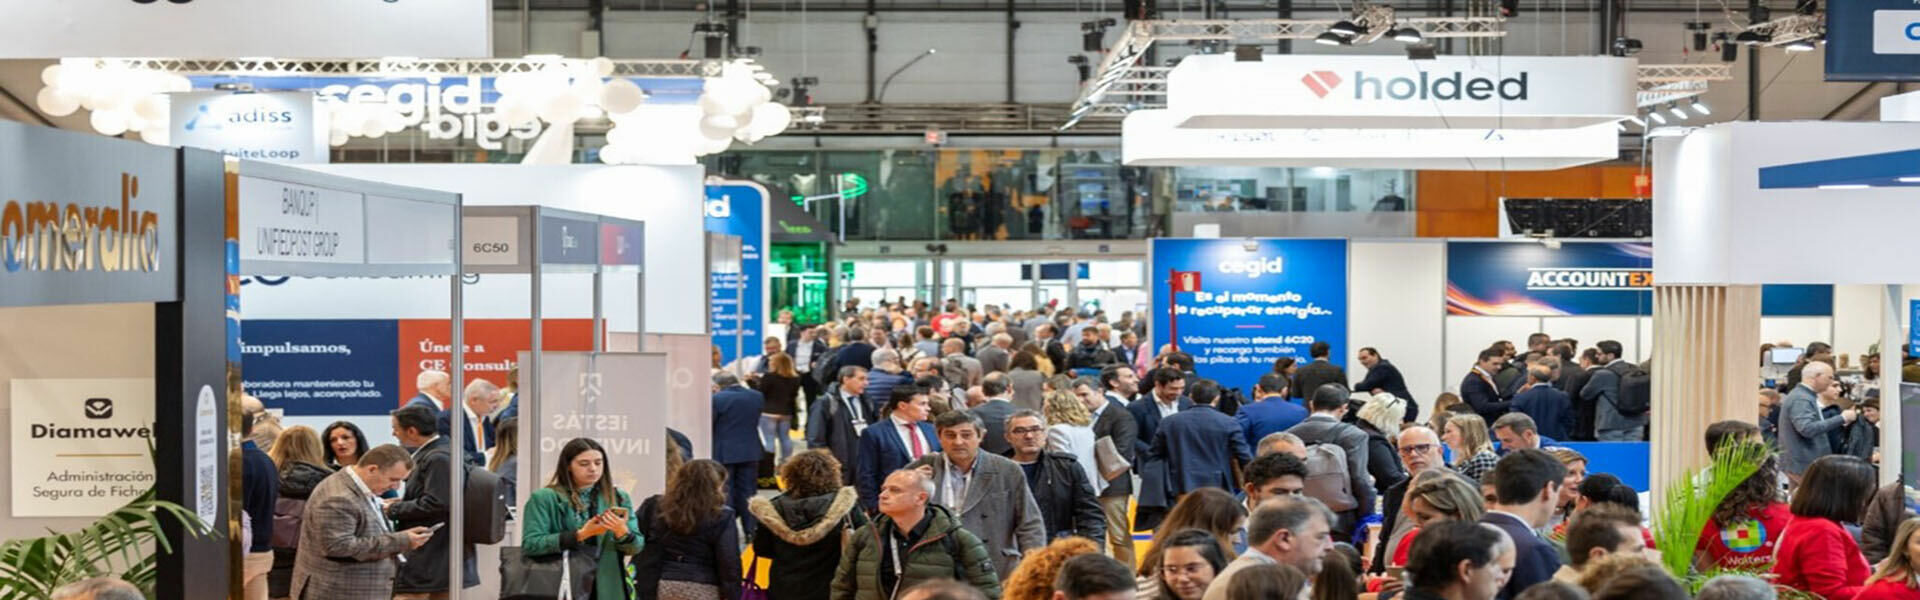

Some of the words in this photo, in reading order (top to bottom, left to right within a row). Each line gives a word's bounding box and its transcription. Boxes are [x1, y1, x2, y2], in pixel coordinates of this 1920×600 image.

[1354, 70, 1528, 101] holded
[228, 107, 292, 123] adiss
[313, 230, 338, 257] GROUP
[473, 243, 509, 253] 6C50
[1218, 256, 1283, 278] cegid
[1195, 291, 1213, 303] Es
[1215, 291, 1230, 304] el
[1231, 291, 1302, 303] momento
[1190, 305, 1263, 318] recuperar
[1213, 337, 1250, 345] nuestro
[1252, 336, 1283, 344] stand
[241, 342, 351, 357] impulsamos,
[474, 344, 484, 353] a
[1213, 348, 1253, 357] recarga
[420, 359, 446, 371] CE
[1210, 355, 1235, 365] pilas
[1236, 355, 1250, 364] de
[1252, 355, 1262, 364] tu
[293, 380, 361, 388] manteniendo
[363, 380, 375, 388] tu
[47, 470, 154, 482] Administración
[33, 486, 83, 500] Segura
[88, 486, 106, 497] de
